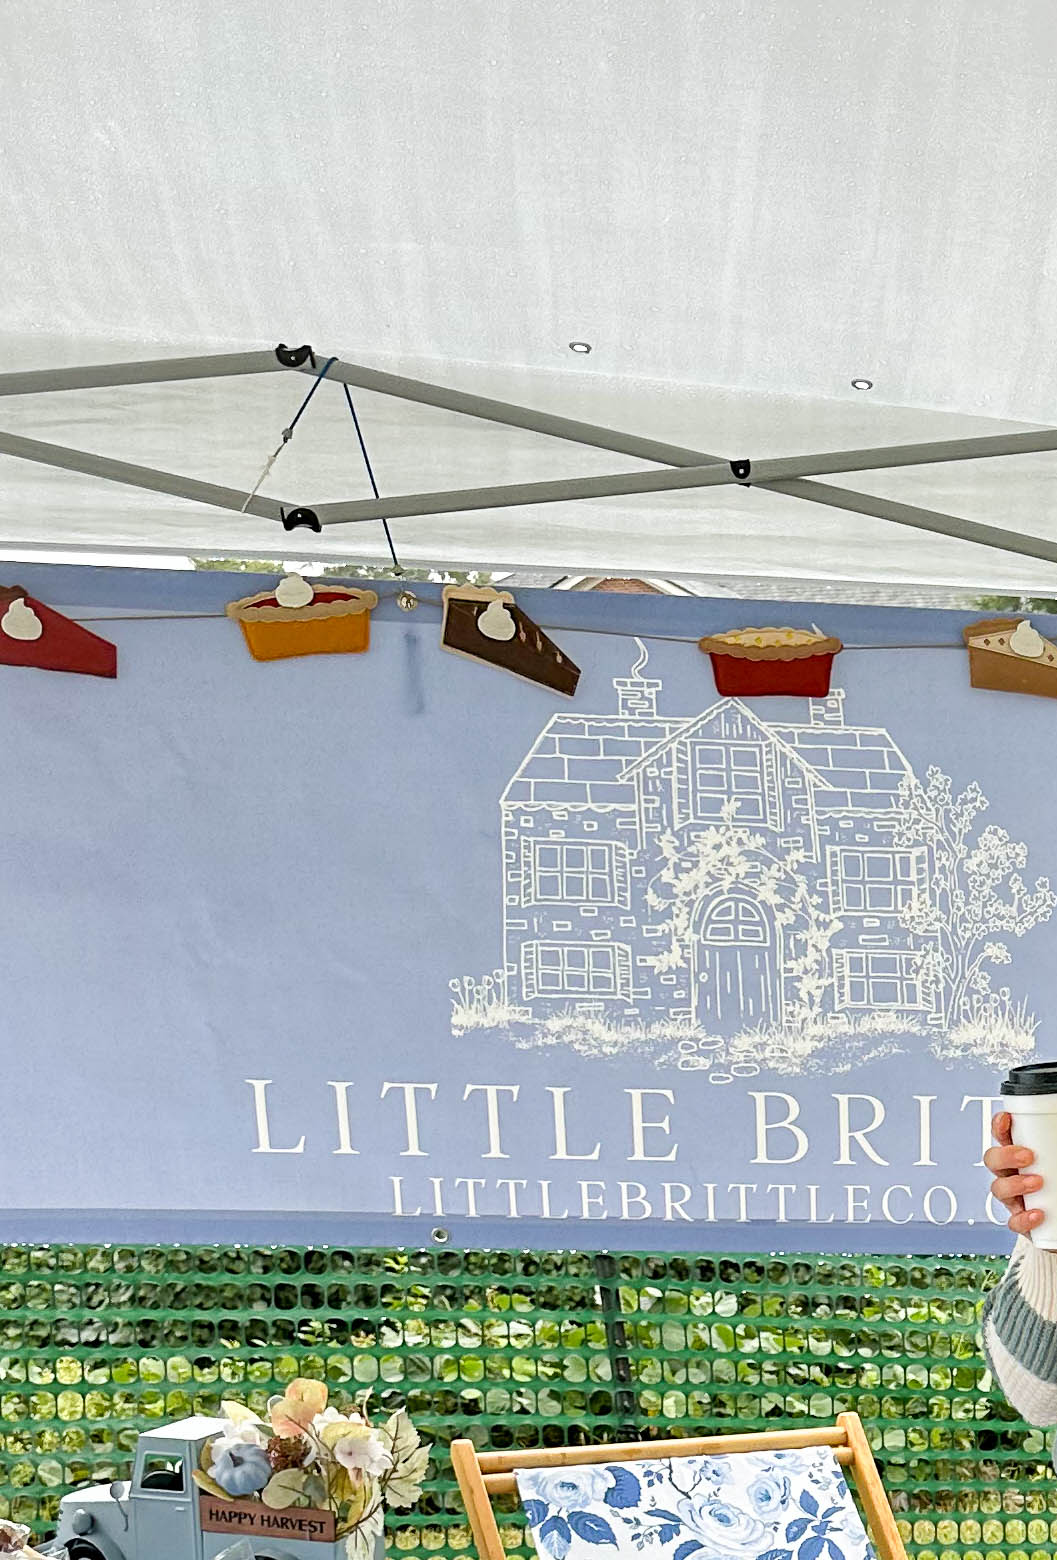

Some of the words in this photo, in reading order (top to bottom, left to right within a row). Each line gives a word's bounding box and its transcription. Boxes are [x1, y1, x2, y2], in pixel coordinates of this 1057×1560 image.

[244, 1078, 680, 1162] LITTLE
[747, 1091, 1005, 1167] BRIT
[388, 1175, 1010, 1226] LITTLEBRITTLECO.C
[209, 1508, 257, 1526] HAPPY
[260, 1514, 326, 1534] HARVEST
